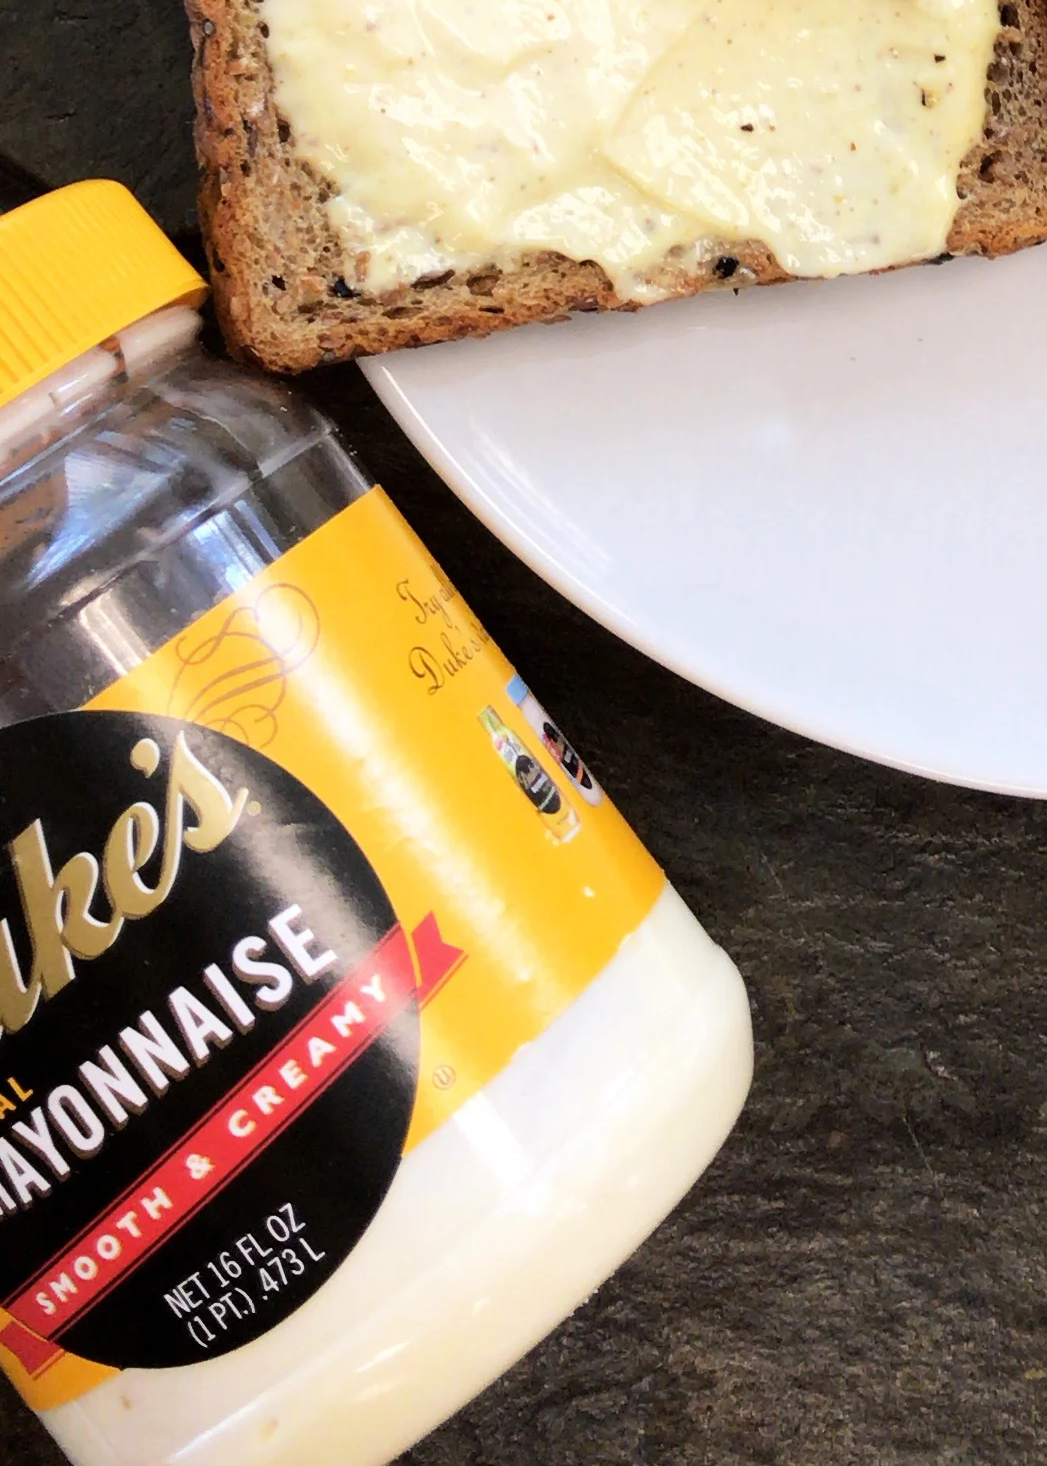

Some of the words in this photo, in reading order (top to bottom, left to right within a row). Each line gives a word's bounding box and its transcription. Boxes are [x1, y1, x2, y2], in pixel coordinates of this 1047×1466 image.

[408, 625, 482, 696] Duke's
[35, 1186, 174, 1316] SMOOTH
[184, 1152, 216, 1180] &
[228, 974, 387, 1137] CREAMY
[163, 1271, 211, 1319] NET
[207, 1251, 242, 1288] 16
[235, 1233, 273, 1266] FL
[266, 1202, 306, 1242] OZ
[187, 1315, 216, 1349] (1
[208, 1287, 256, 1330] PT.)
[262, 1248, 305, 1300] .473
[299, 1238, 326, 1262] L
